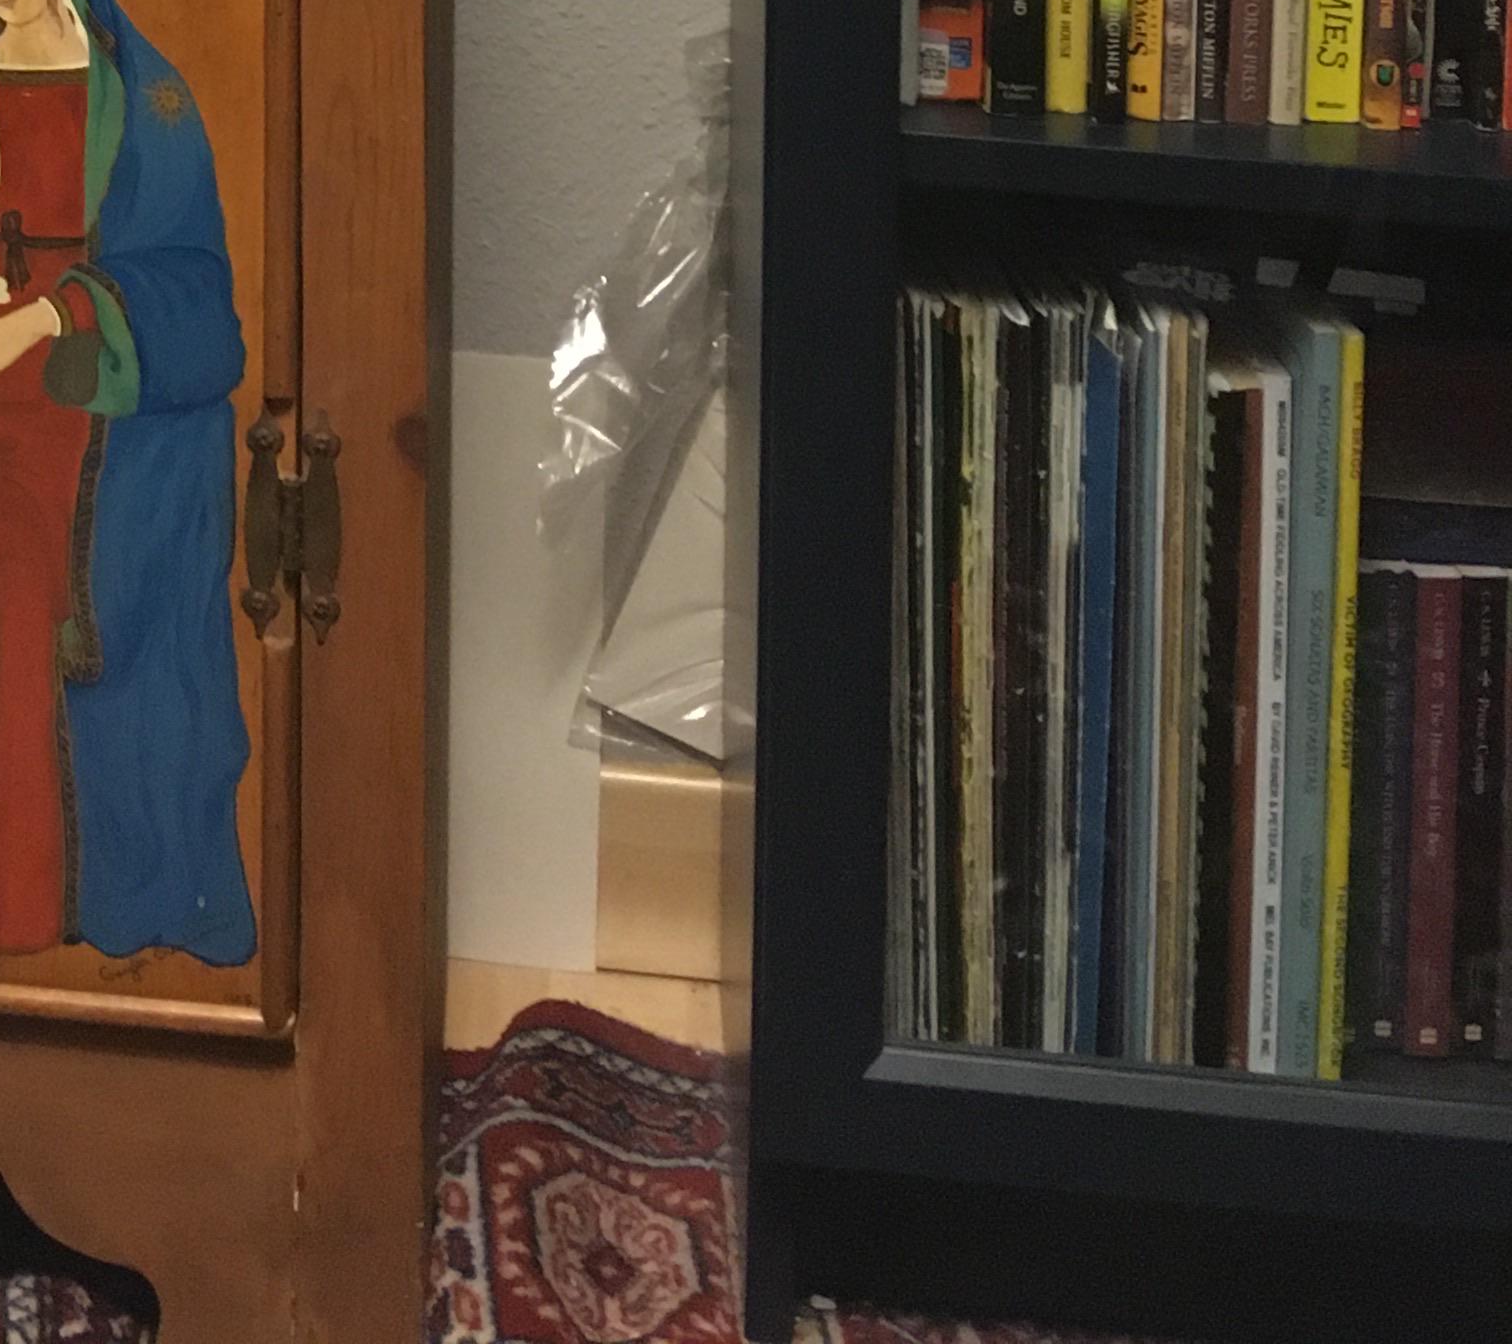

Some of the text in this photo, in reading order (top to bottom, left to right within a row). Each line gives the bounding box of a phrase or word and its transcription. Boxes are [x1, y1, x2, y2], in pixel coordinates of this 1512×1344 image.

[1059, 20, 1072, 59] HOUSE
[1201, 37, 1216, 100] MIFFLIN
[1241, 53, 1257, 102] PRESS
[1345, 595, 1357, 648] VICTIM
[1344, 652, 1356, 670] OF
